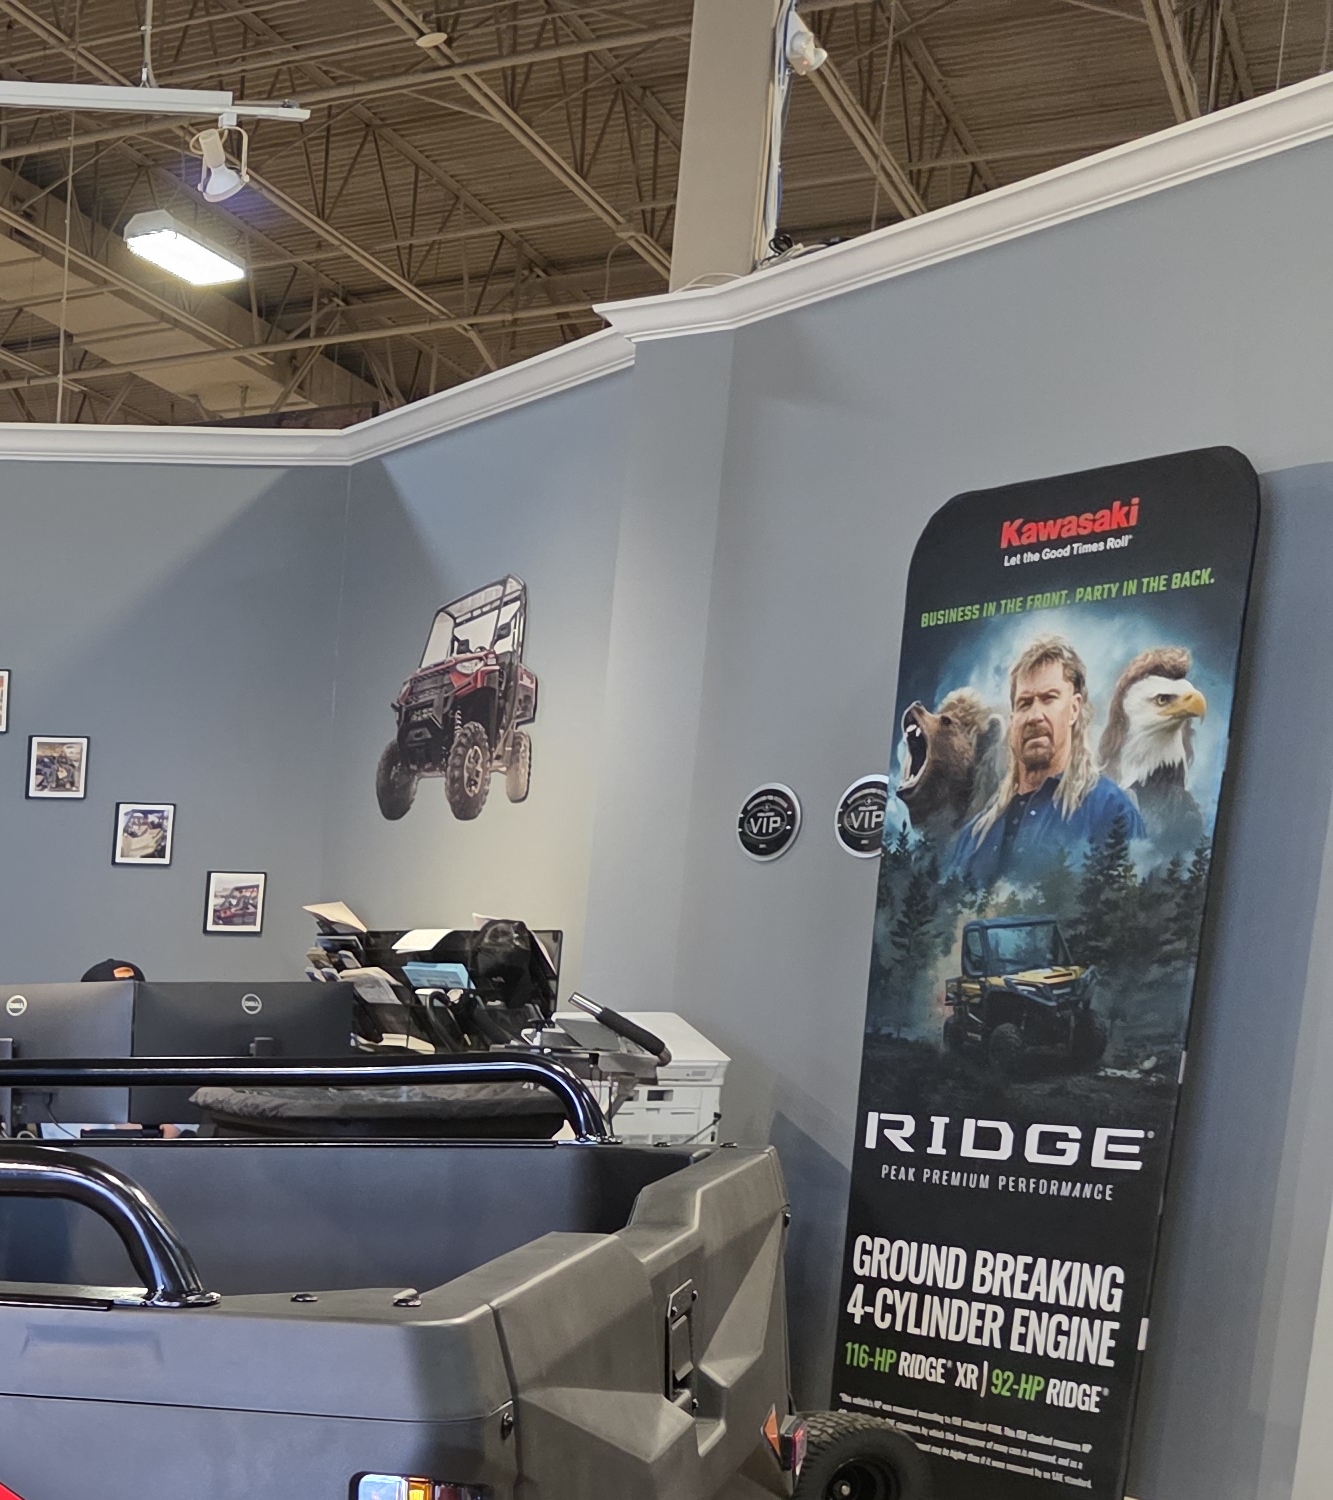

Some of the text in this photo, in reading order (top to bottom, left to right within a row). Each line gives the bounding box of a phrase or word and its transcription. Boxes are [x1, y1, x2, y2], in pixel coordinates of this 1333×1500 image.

[1000, 497, 1140, 549] Kawasaki
[1004, 553, 1021, 567] Let
[1023, 550, 1040, 563] the
[1041, 544, 1070, 560] Good
[1072, 541, 1105, 555] Times
[920, 567, 1216, 628] BUSINESS IN THE FRONT. PARTY IN THE BACK.
[749, 816, 782, 834] VIP
[850, 810, 884, 829] VIP
[864, 1111, 1146, 1171] RIDGE
[881, 1164, 1114, 1201] PEAK PREMIUM PERFORMANCE
[852, 1234, 1125, 1314] GROUND BREAKING
[846, 1282, 1121, 1368] 4-CYLINDER ENGINE
[844, 1341, 898, 1374] 116-HP
[954, 1361, 979, 1391] XR
[990, 1367, 1045, 1402] 92-HP
